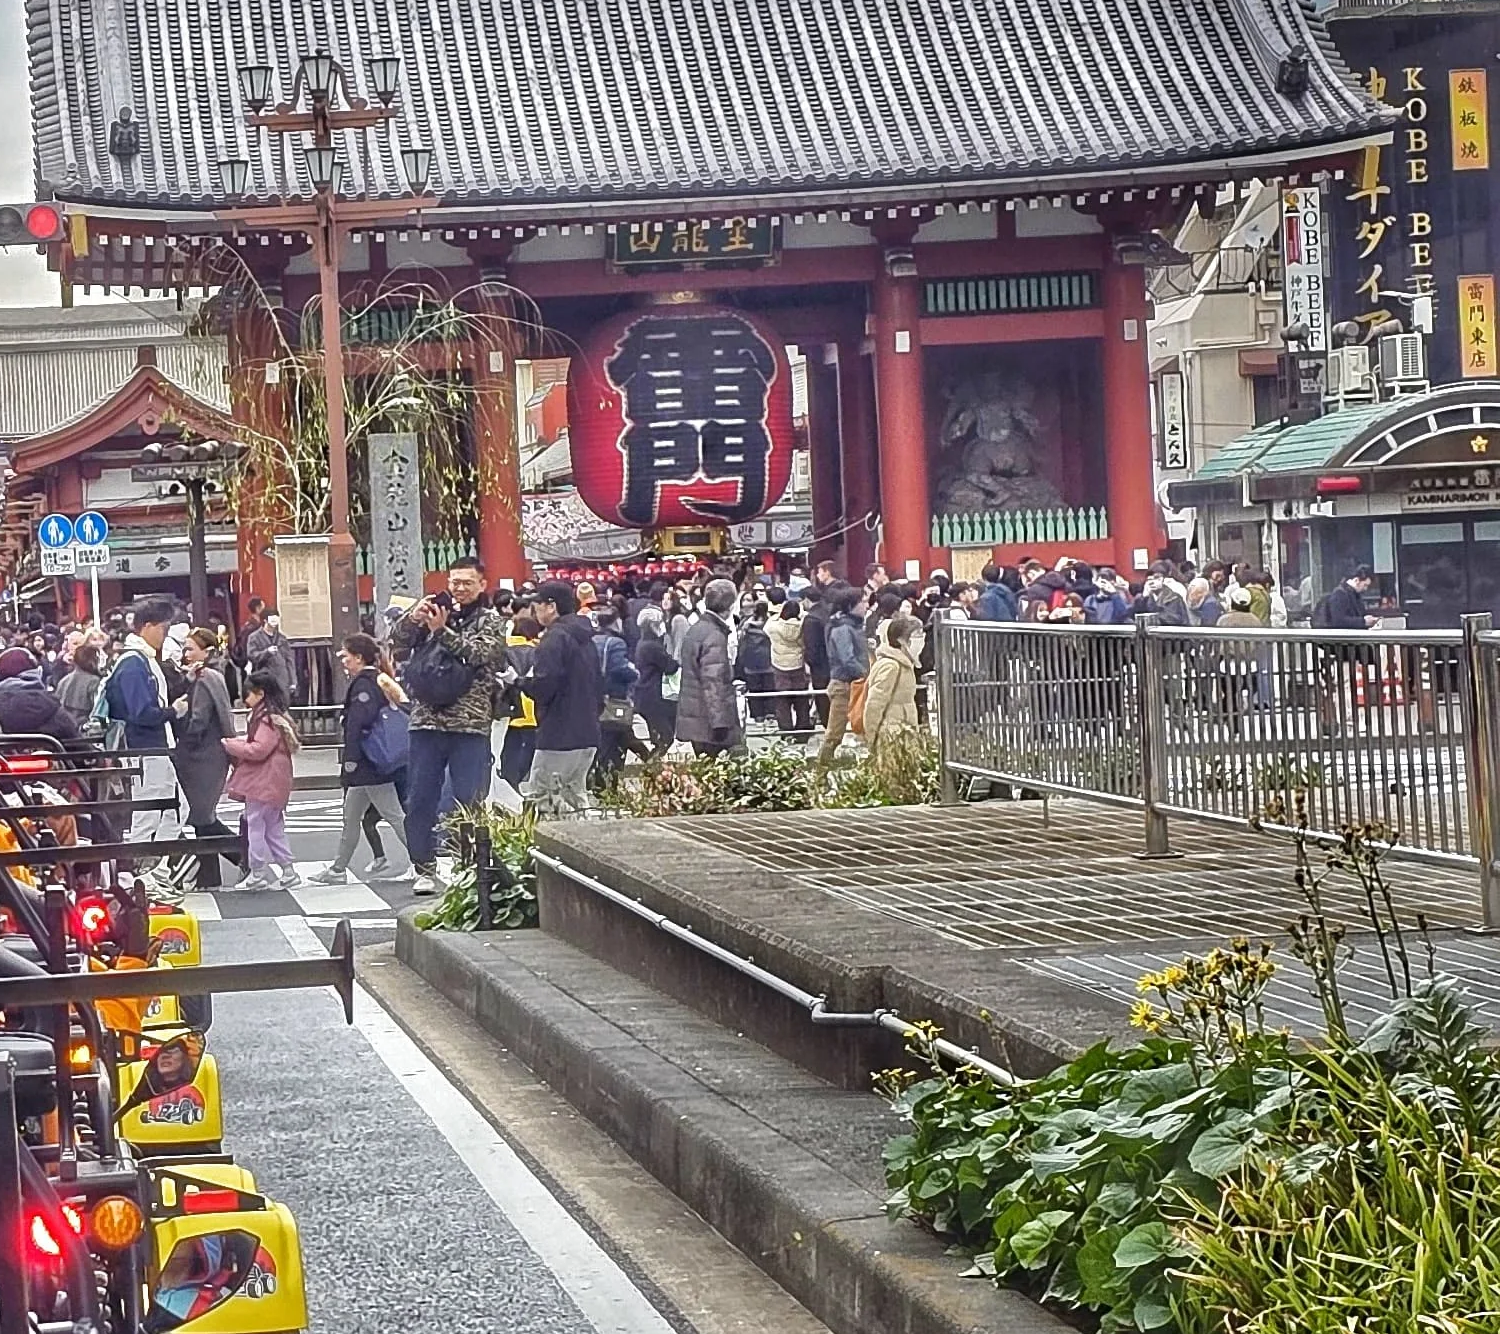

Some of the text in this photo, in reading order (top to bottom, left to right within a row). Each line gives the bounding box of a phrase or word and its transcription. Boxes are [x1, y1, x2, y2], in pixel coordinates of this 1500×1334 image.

[1458, 77, 1479, 159] 鉄板焼
[1402, 67, 1434, 319] KOBE BEE
[1303, 192, 1321, 347] KOBE BEEF
[1467, 283, 1488, 368] 雷門東店
[604, 312, 778, 525] 雷門
[1407, 493, 1490, 505] KAMINARIMON
